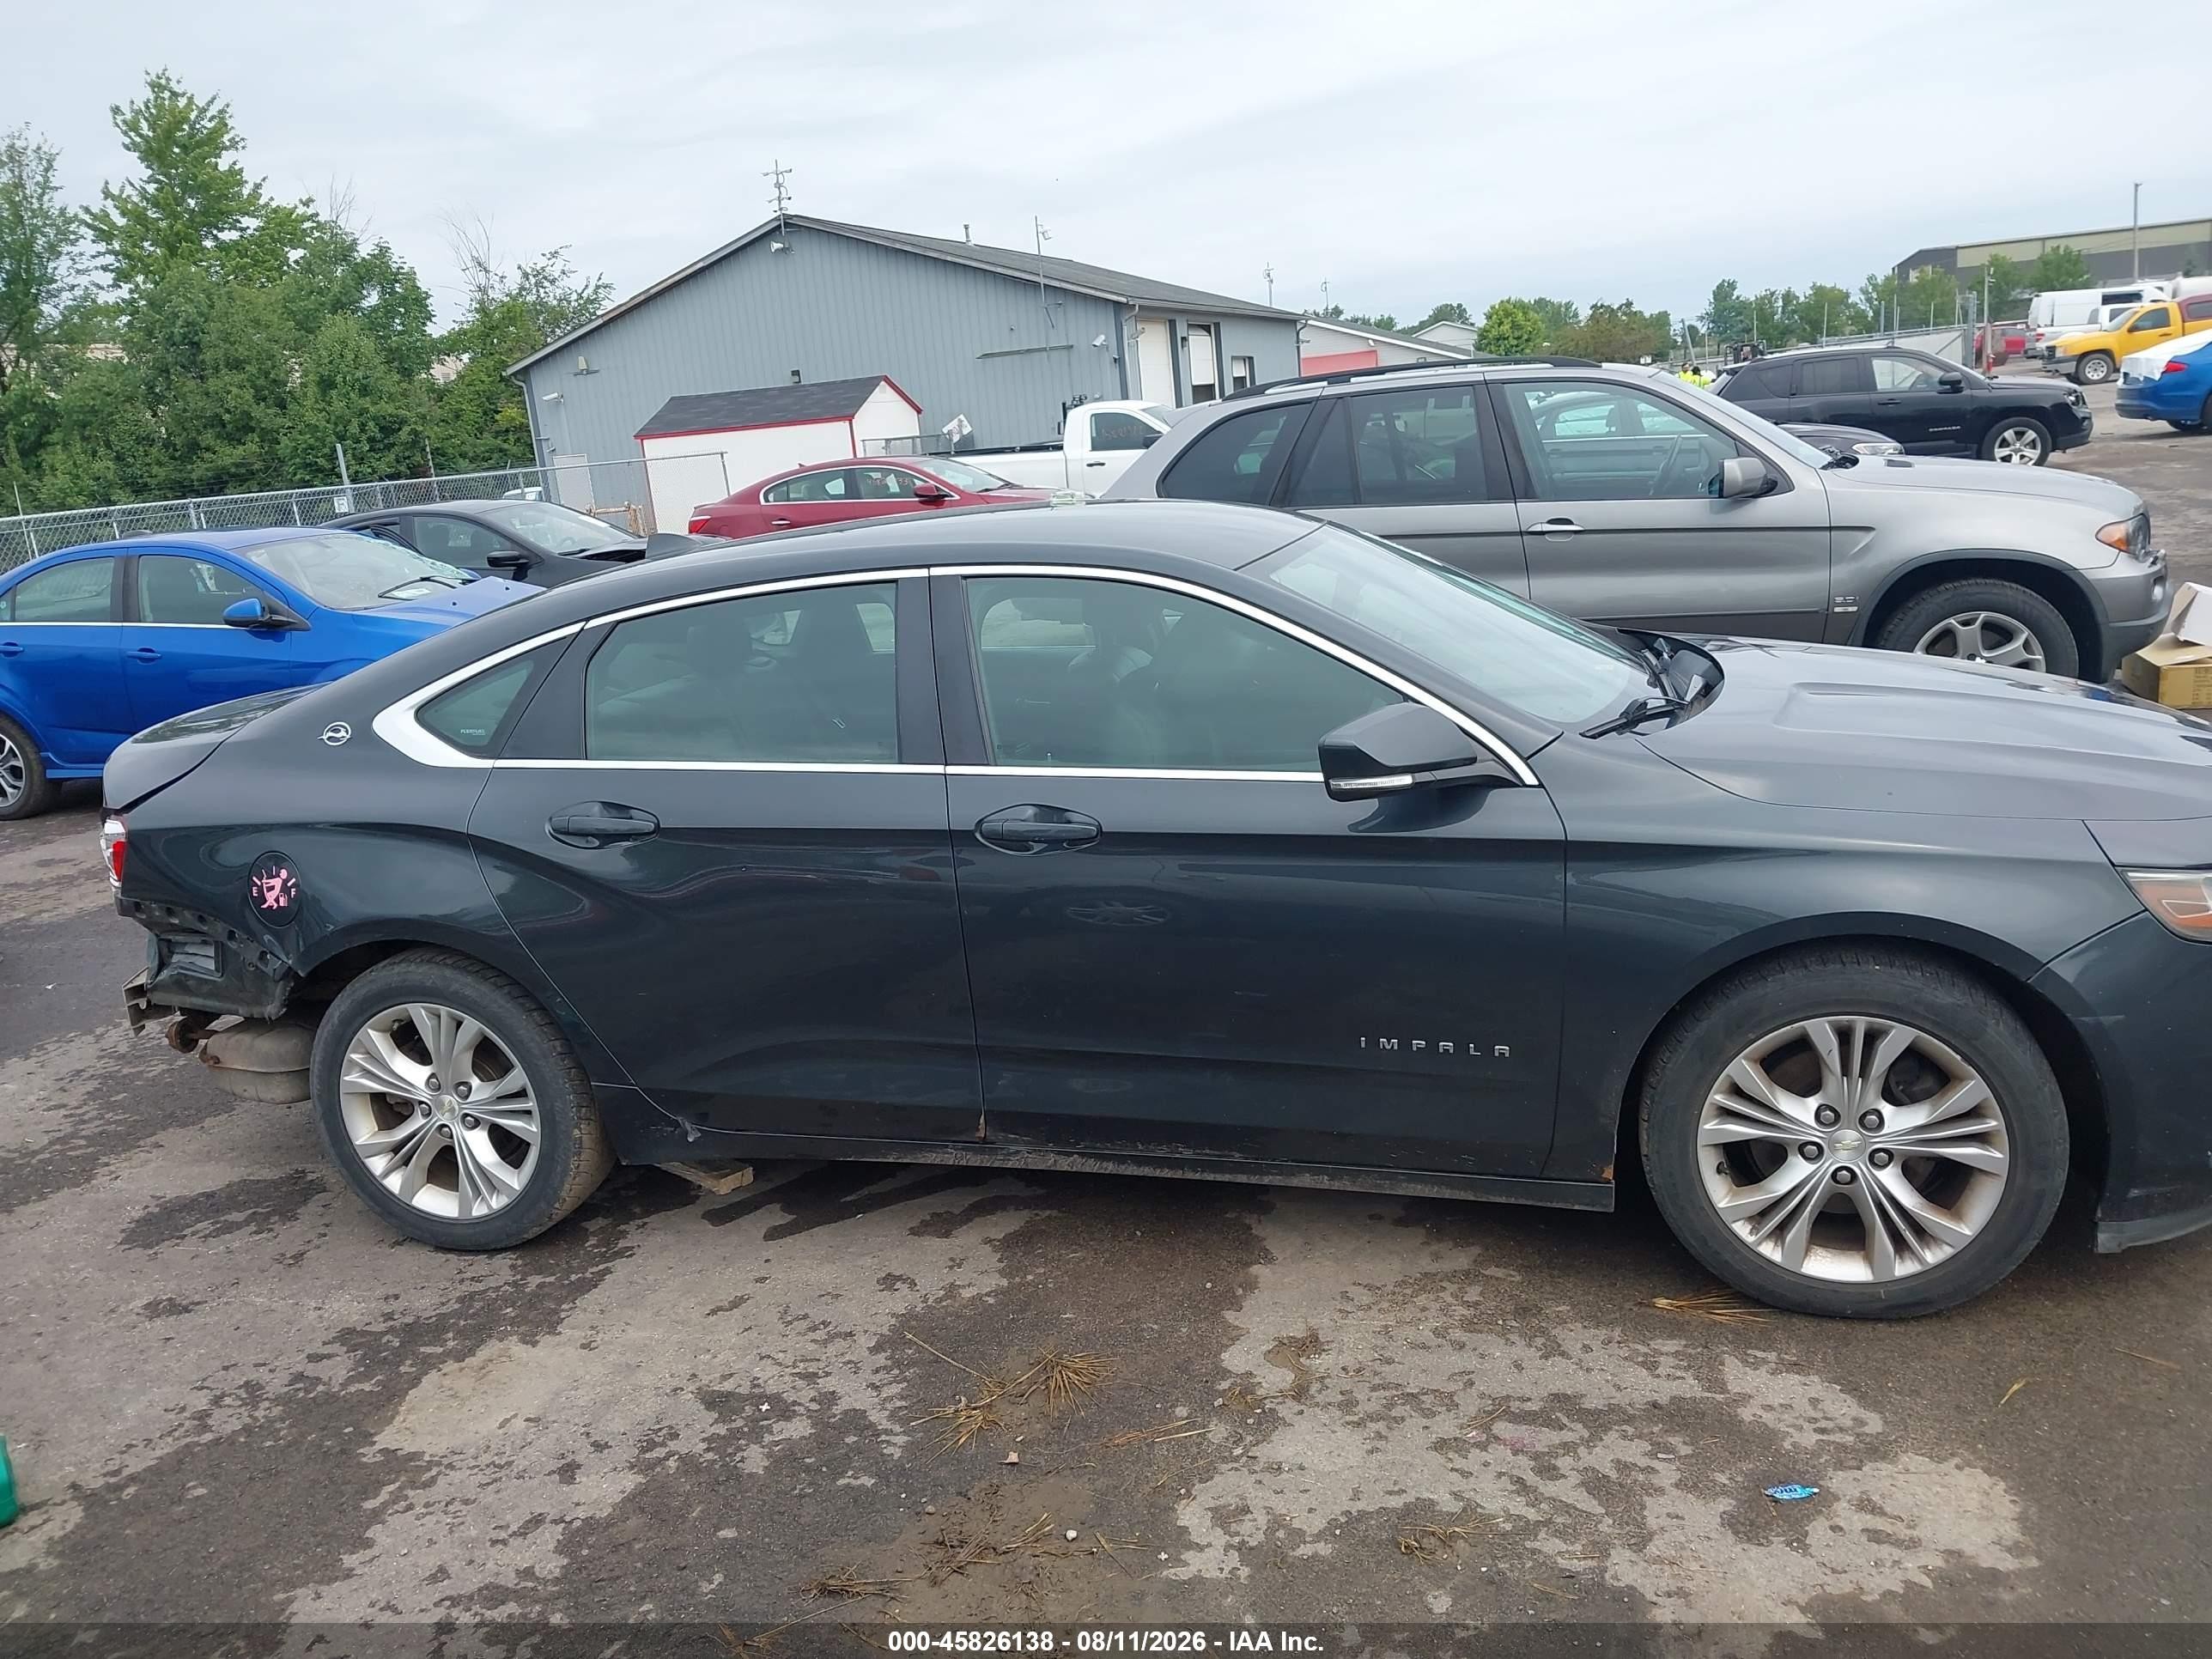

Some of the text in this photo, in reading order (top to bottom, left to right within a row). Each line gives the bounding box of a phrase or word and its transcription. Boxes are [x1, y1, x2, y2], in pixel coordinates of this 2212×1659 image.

[252, 887, 296, 899] E F
[1359, 1036, 1510, 1057] IMPALA
